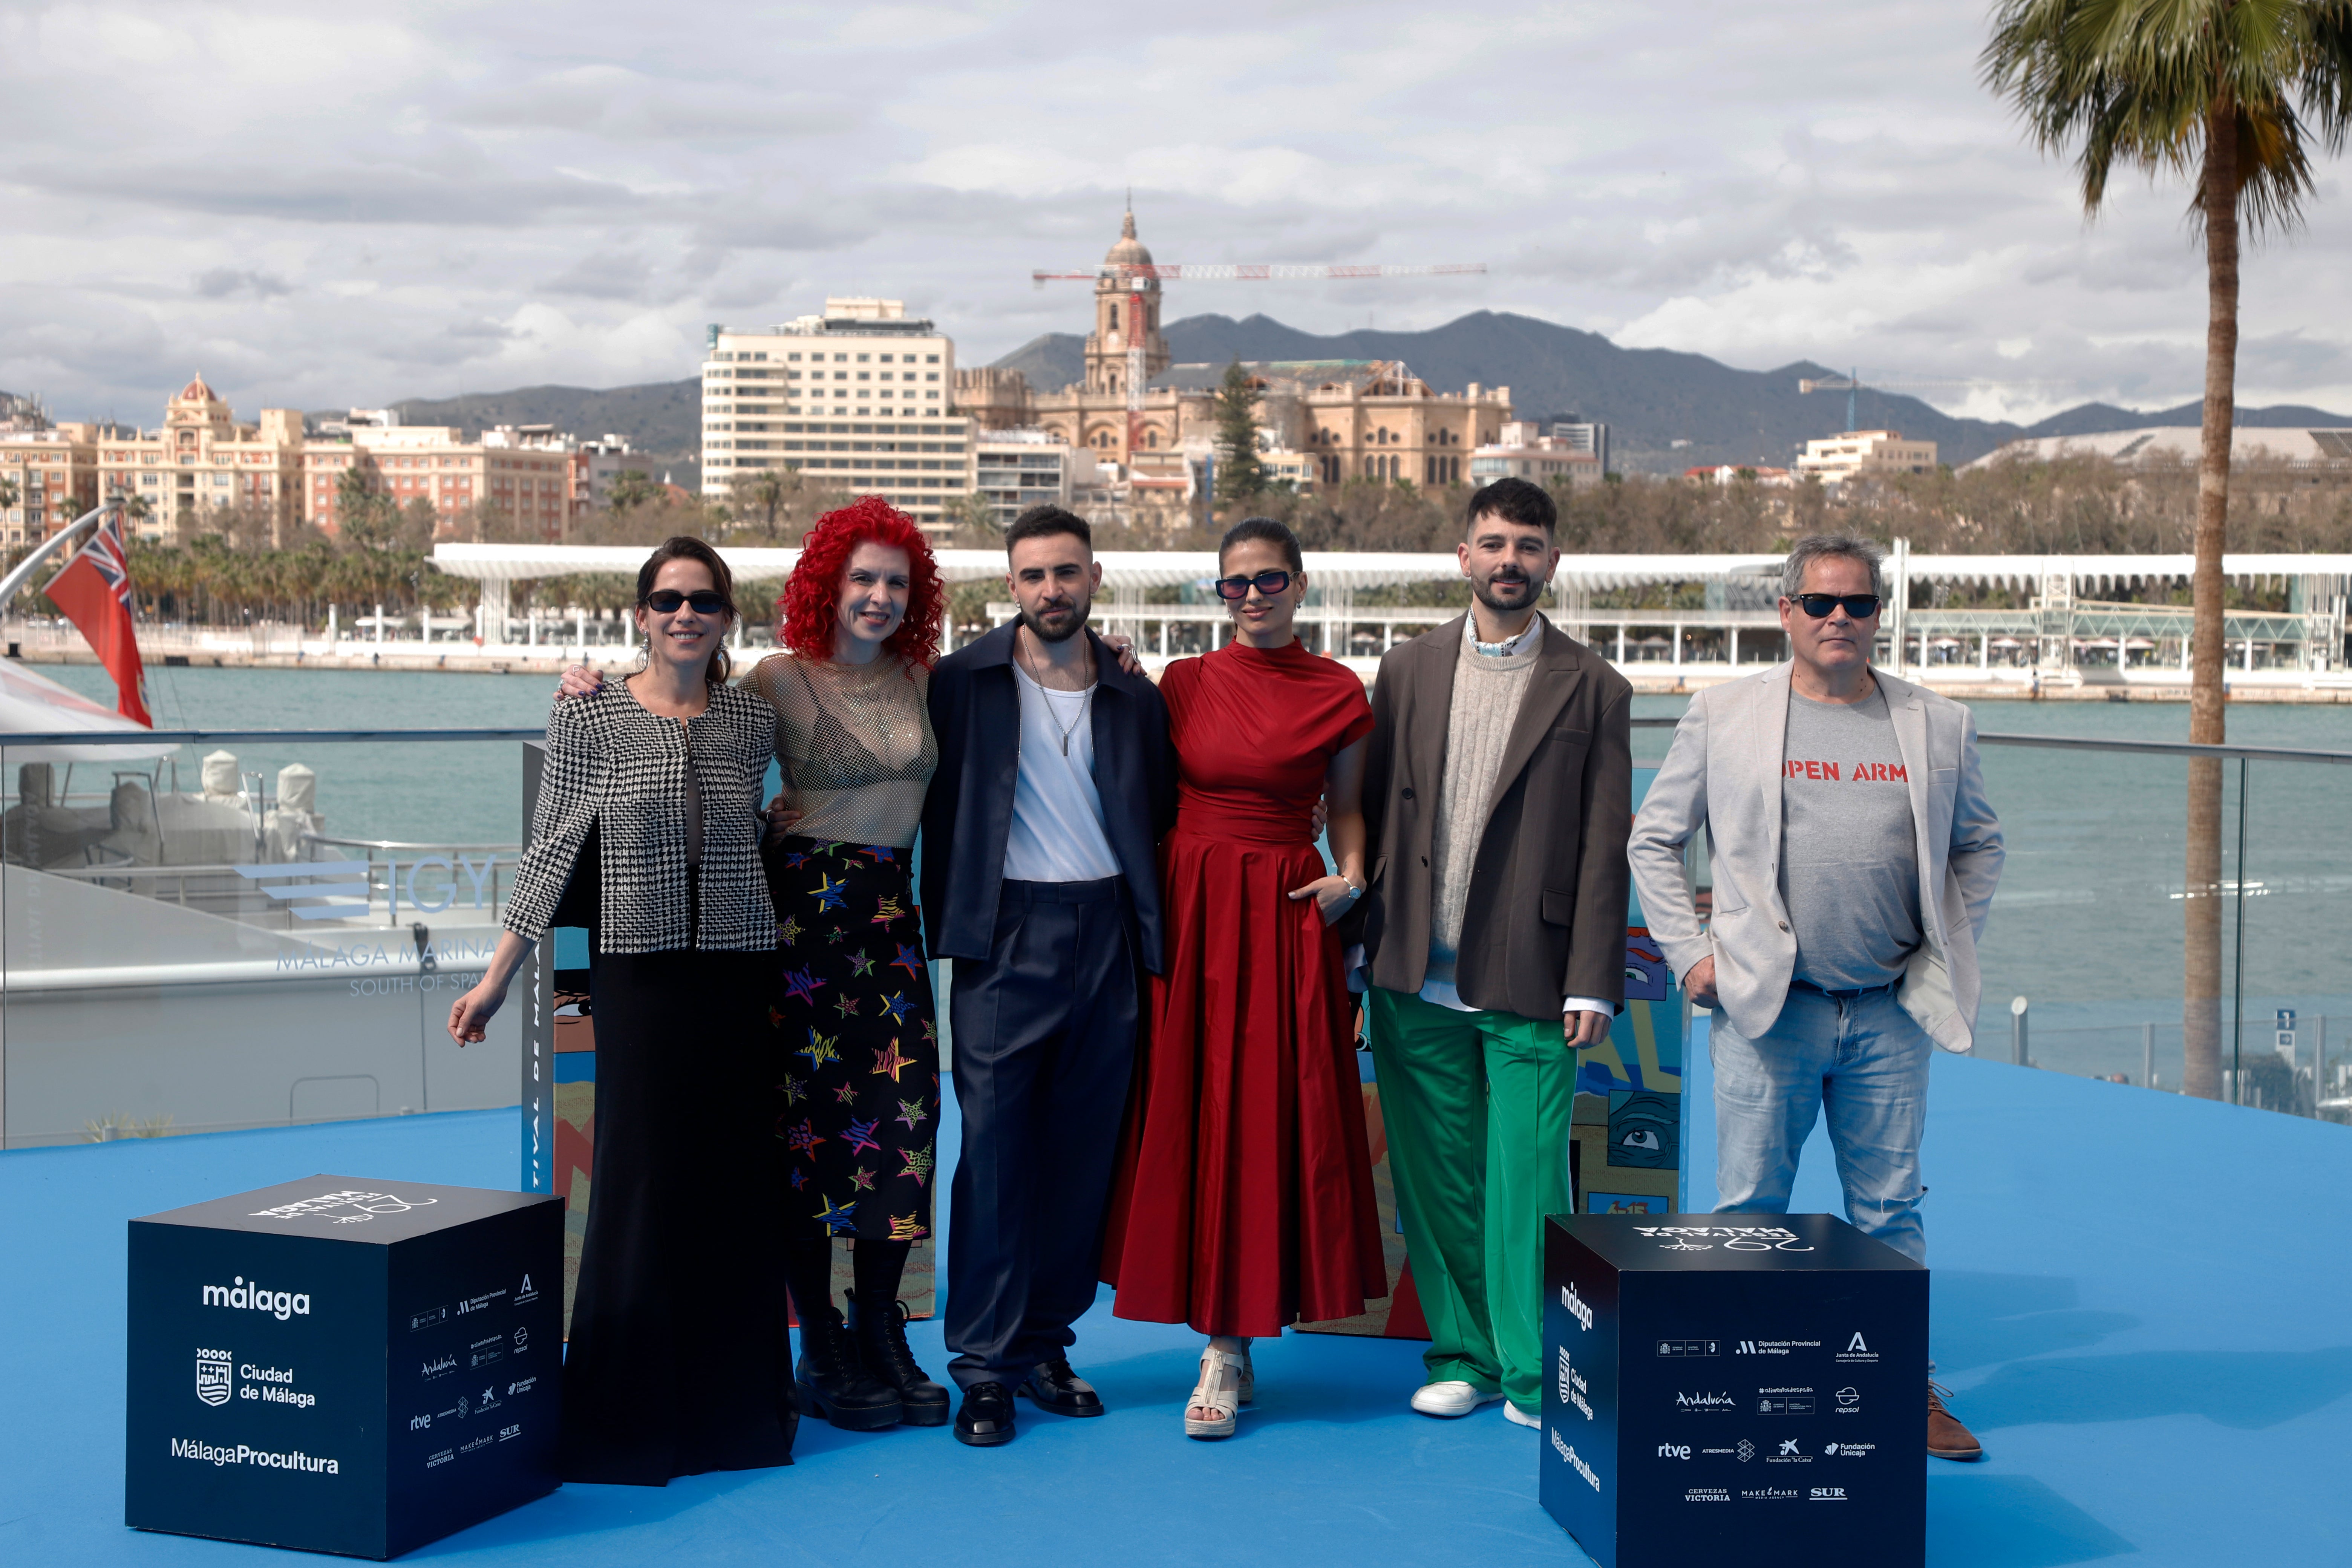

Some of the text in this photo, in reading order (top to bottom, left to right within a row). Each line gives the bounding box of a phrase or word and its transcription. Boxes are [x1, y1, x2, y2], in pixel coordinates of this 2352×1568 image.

[1782, 760, 1908, 783] PEN ARM
[389, 854, 497, 915] IGY
[276, 937, 496, 971] MÁLAGA MARINA
[350, 972, 484, 997] SOUTH OF SPAI
[2282, 1012, 2290, 1029] 1
[533, 1040, 539, 1082] DE
[300, 1192, 383, 1211] FESTIVAL
[470, 1288, 506, 1305] Diputación Provincial
[475, 1301, 488, 1311] Málaga
[514, 1344, 528, 1354] repsol
[240, 1364, 293, 1384] Ciudad
[421, 1354, 458, 1377] Andalucía
[516, 1385, 531, 1394] Unicaja
[517, 1377, 536, 1387] Fundación
[1571, 1367, 1587, 1395] Ciudad
[240, 1384, 315, 1408] de Málaga
[1570, 1387, 1593, 1421] de Málaga
[1675, 1391, 1736, 1406] Andalucía
[437, 1408, 457, 1418] ATRESMEDIA
[474, 1406, 490, 1415] Fundación
[410, 1414, 431, 1431] rtve
[499, 1424, 520, 1438] SUR
[172, 1438, 338, 1475] MálagaProcultura
[429, 1448, 452, 1461] CERVEZAS
[1551, 1426, 1600, 1492] MálagaProcultura
[1658, 1442, 1691, 1460] rtve
[427, 1453, 454, 1468] VICTORIA
[1810, 1487, 1846, 1497] SUR
